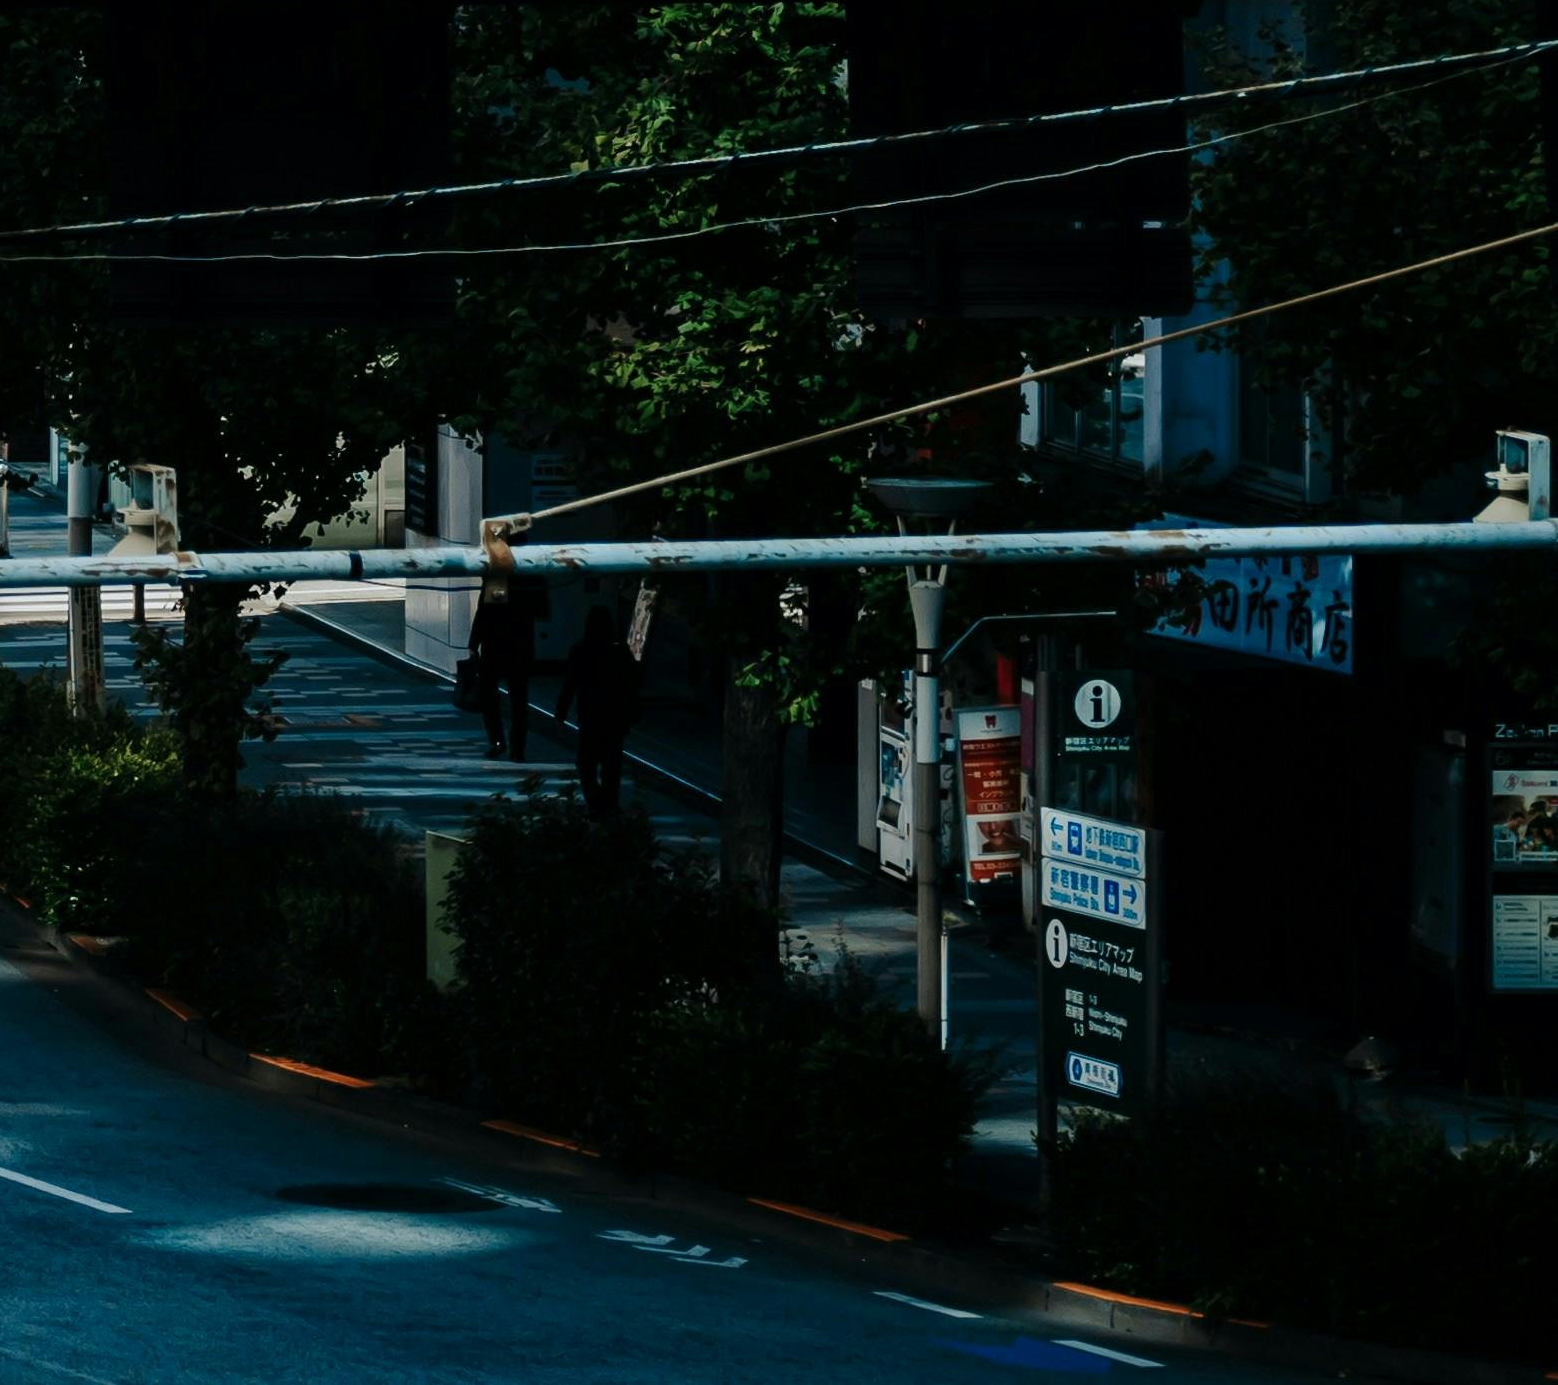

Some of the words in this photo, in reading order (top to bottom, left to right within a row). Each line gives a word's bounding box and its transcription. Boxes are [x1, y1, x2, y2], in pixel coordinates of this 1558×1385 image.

[1068, 932, 1135, 965] 新宿区エリアマップ
